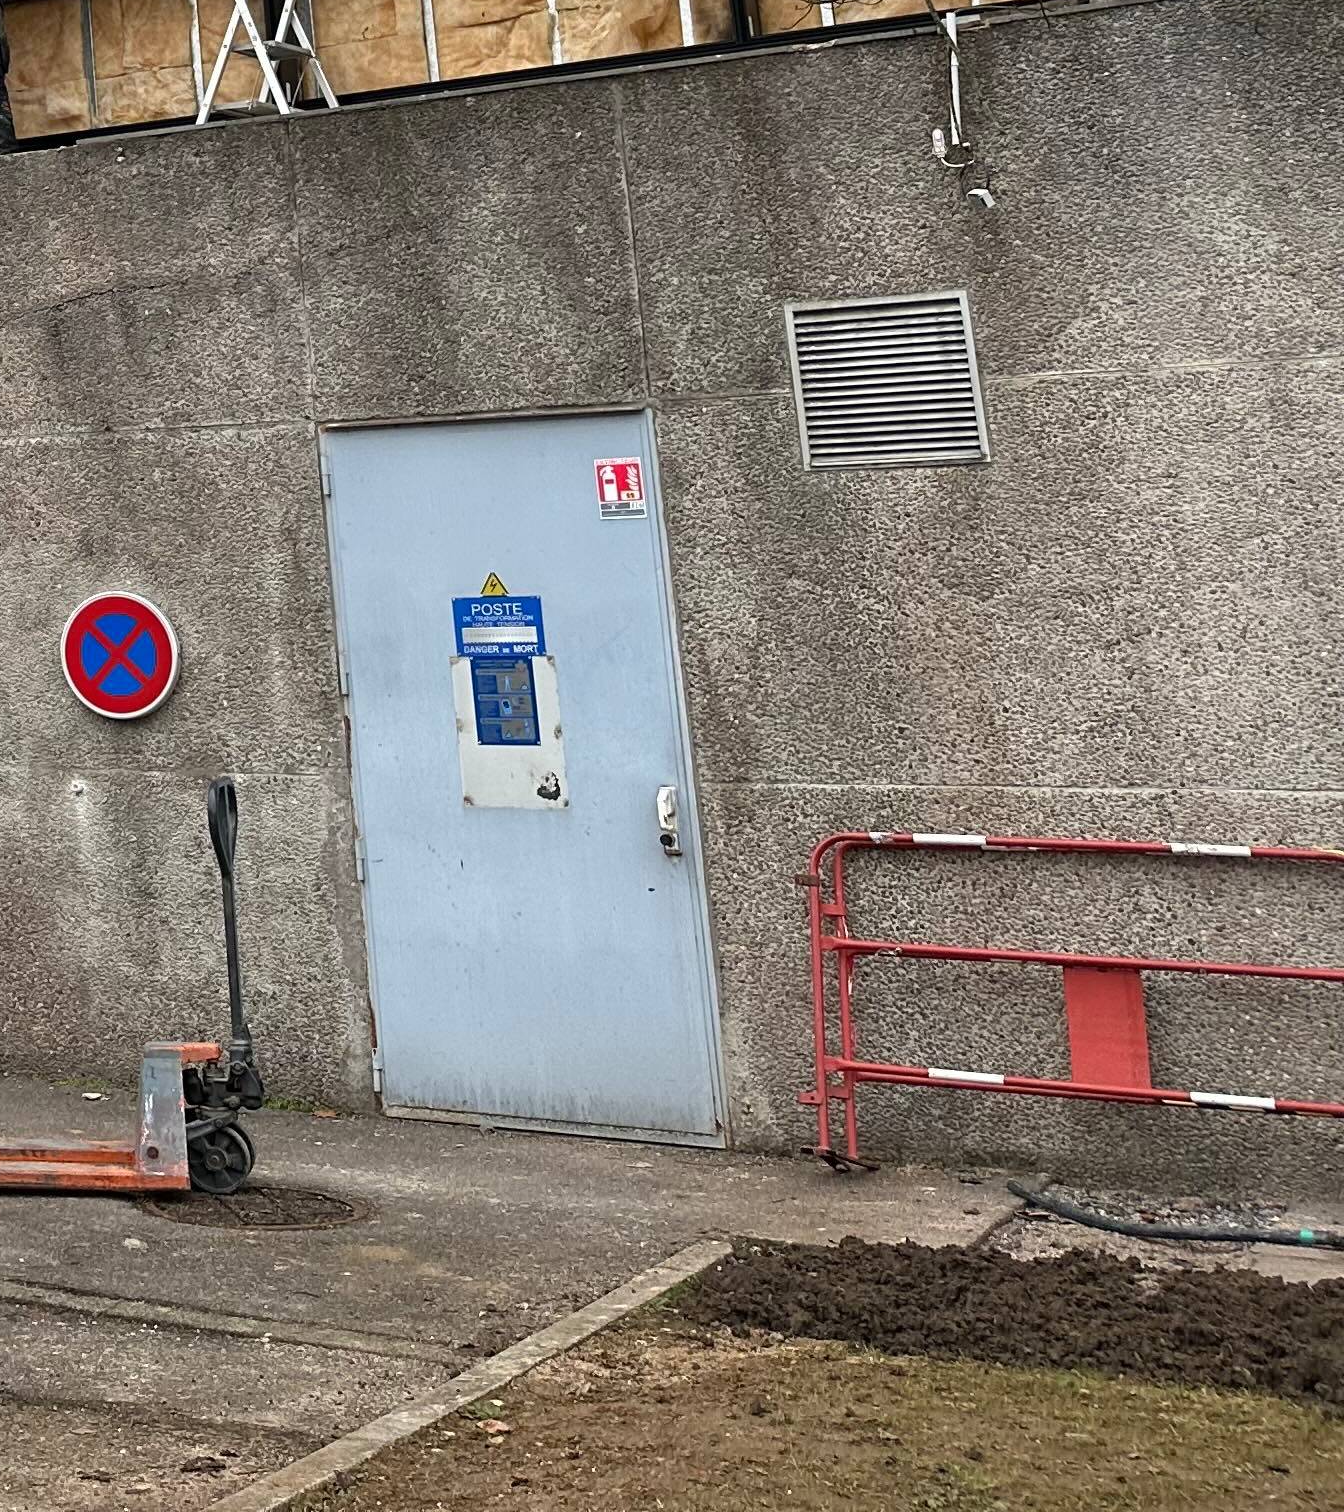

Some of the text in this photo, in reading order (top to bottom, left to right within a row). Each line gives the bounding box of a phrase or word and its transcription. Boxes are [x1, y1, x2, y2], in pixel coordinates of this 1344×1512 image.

[470, 603, 522, 616] POSTE
[463, 645, 500, 654] DANGER
[513, 644, 539, 654] MORT
